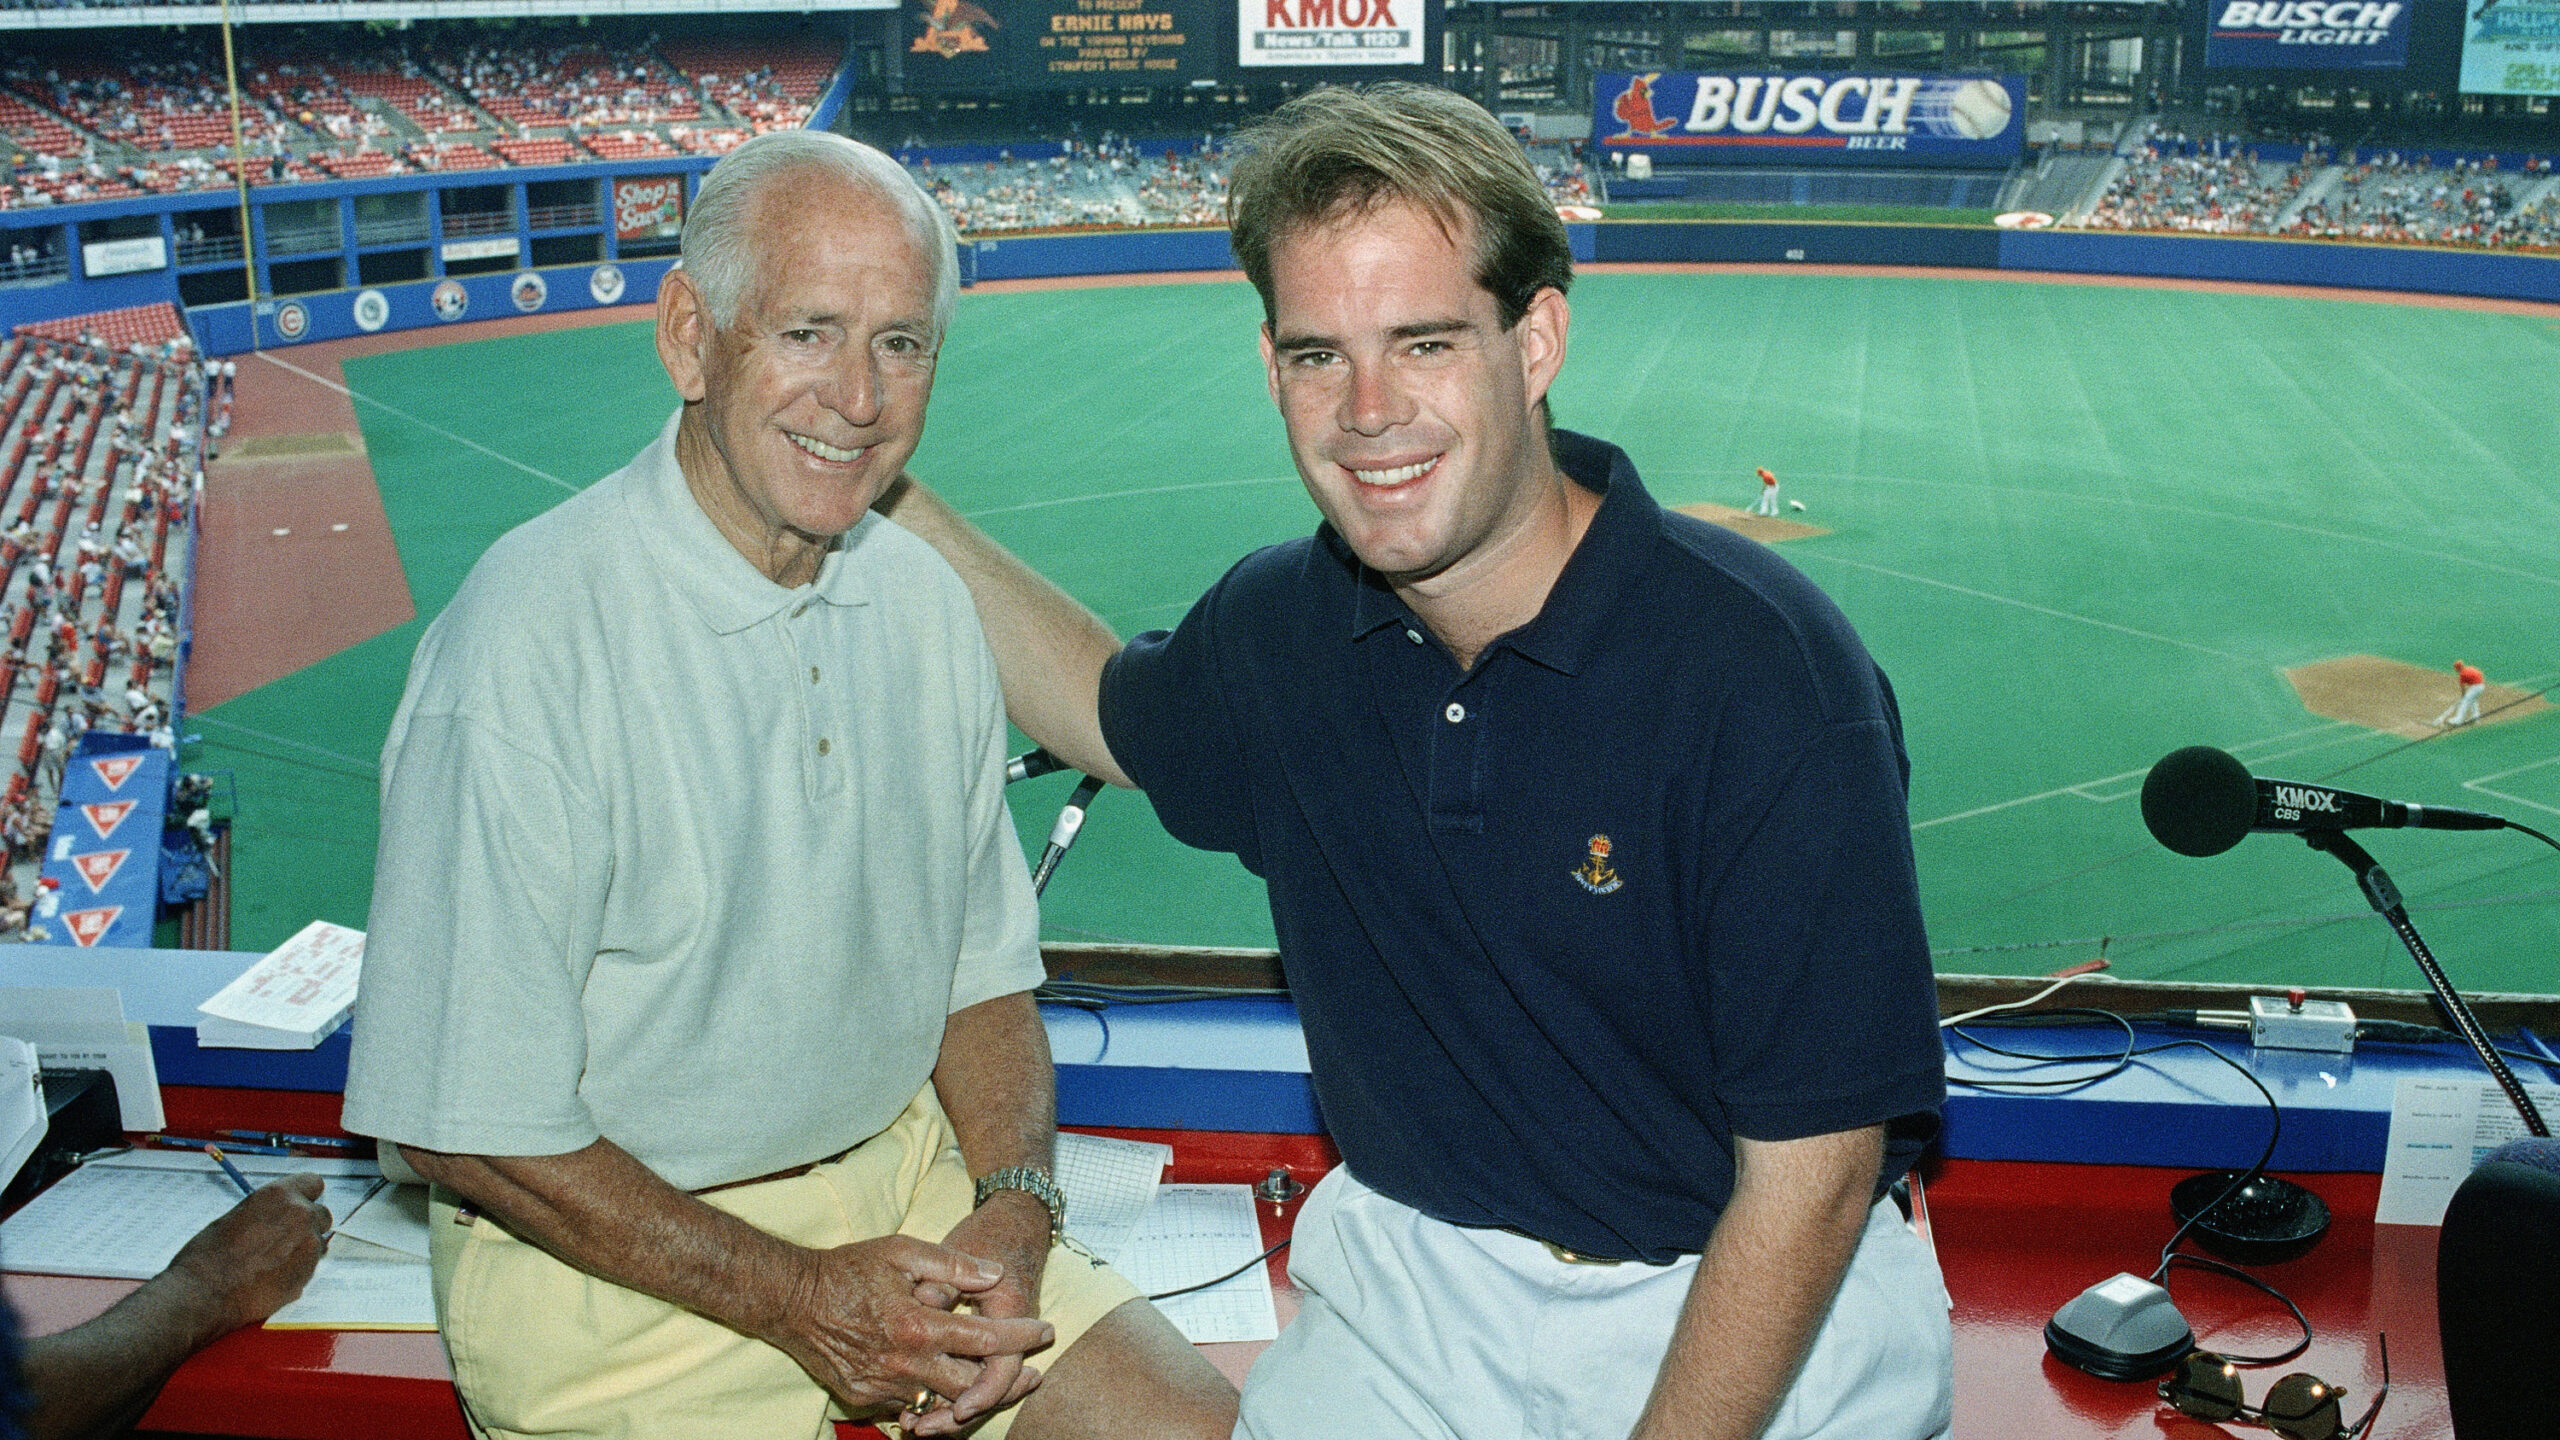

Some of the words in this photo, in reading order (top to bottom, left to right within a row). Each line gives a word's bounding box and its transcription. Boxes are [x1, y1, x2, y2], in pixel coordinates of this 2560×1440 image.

[1051, 14, 1115, 31] ERNIE
[1118, 13, 1173, 30] HAYS
[1266, 0, 1397, 28] KMOX
[2218, 1, 2402, 28] BUSCH
[1264, 33, 1357, 47] News/Talk
[1362, 33, 1400, 47] 1120
[2278, 29, 2389, 44] LIGHT
[1685, 76, 1921, 134] BUSCH
[1847, 137, 1906, 150] BEER
[616, 182, 666, 209] Shop
[2276, 786, 2336, 812] KMOX
[2275, 808, 2300, 821] CBS
